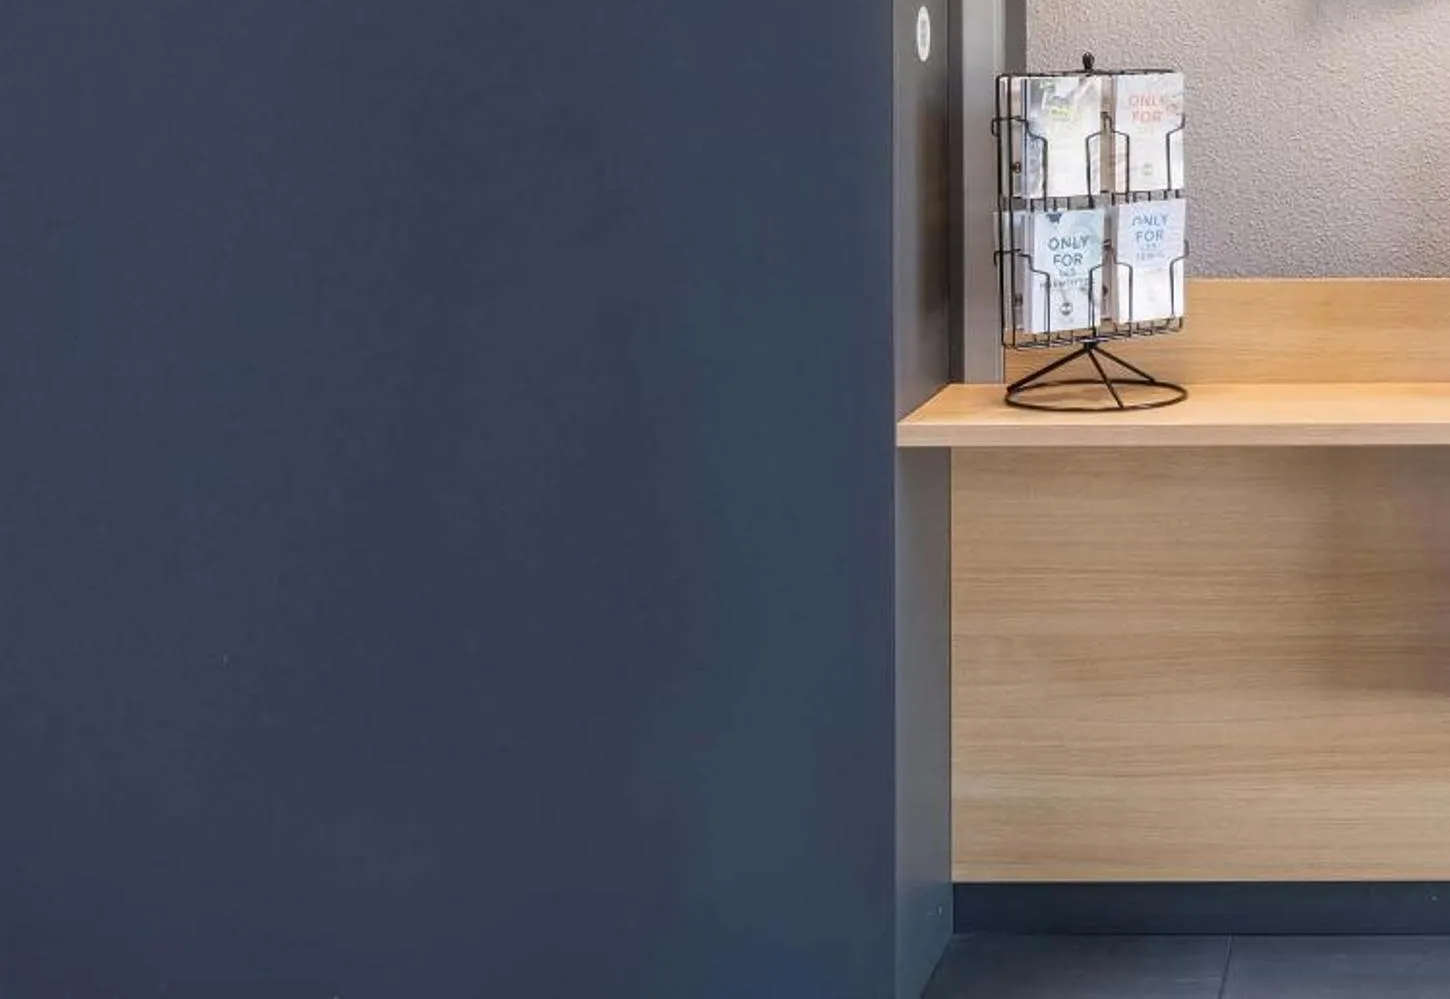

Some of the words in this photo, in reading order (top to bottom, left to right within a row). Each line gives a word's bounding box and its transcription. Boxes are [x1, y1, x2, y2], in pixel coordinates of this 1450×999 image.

[1047, 235, 1090, 251] ONLY
[1135, 229, 1164, 242] FOR
[1053, 252, 1083, 267] FOR
